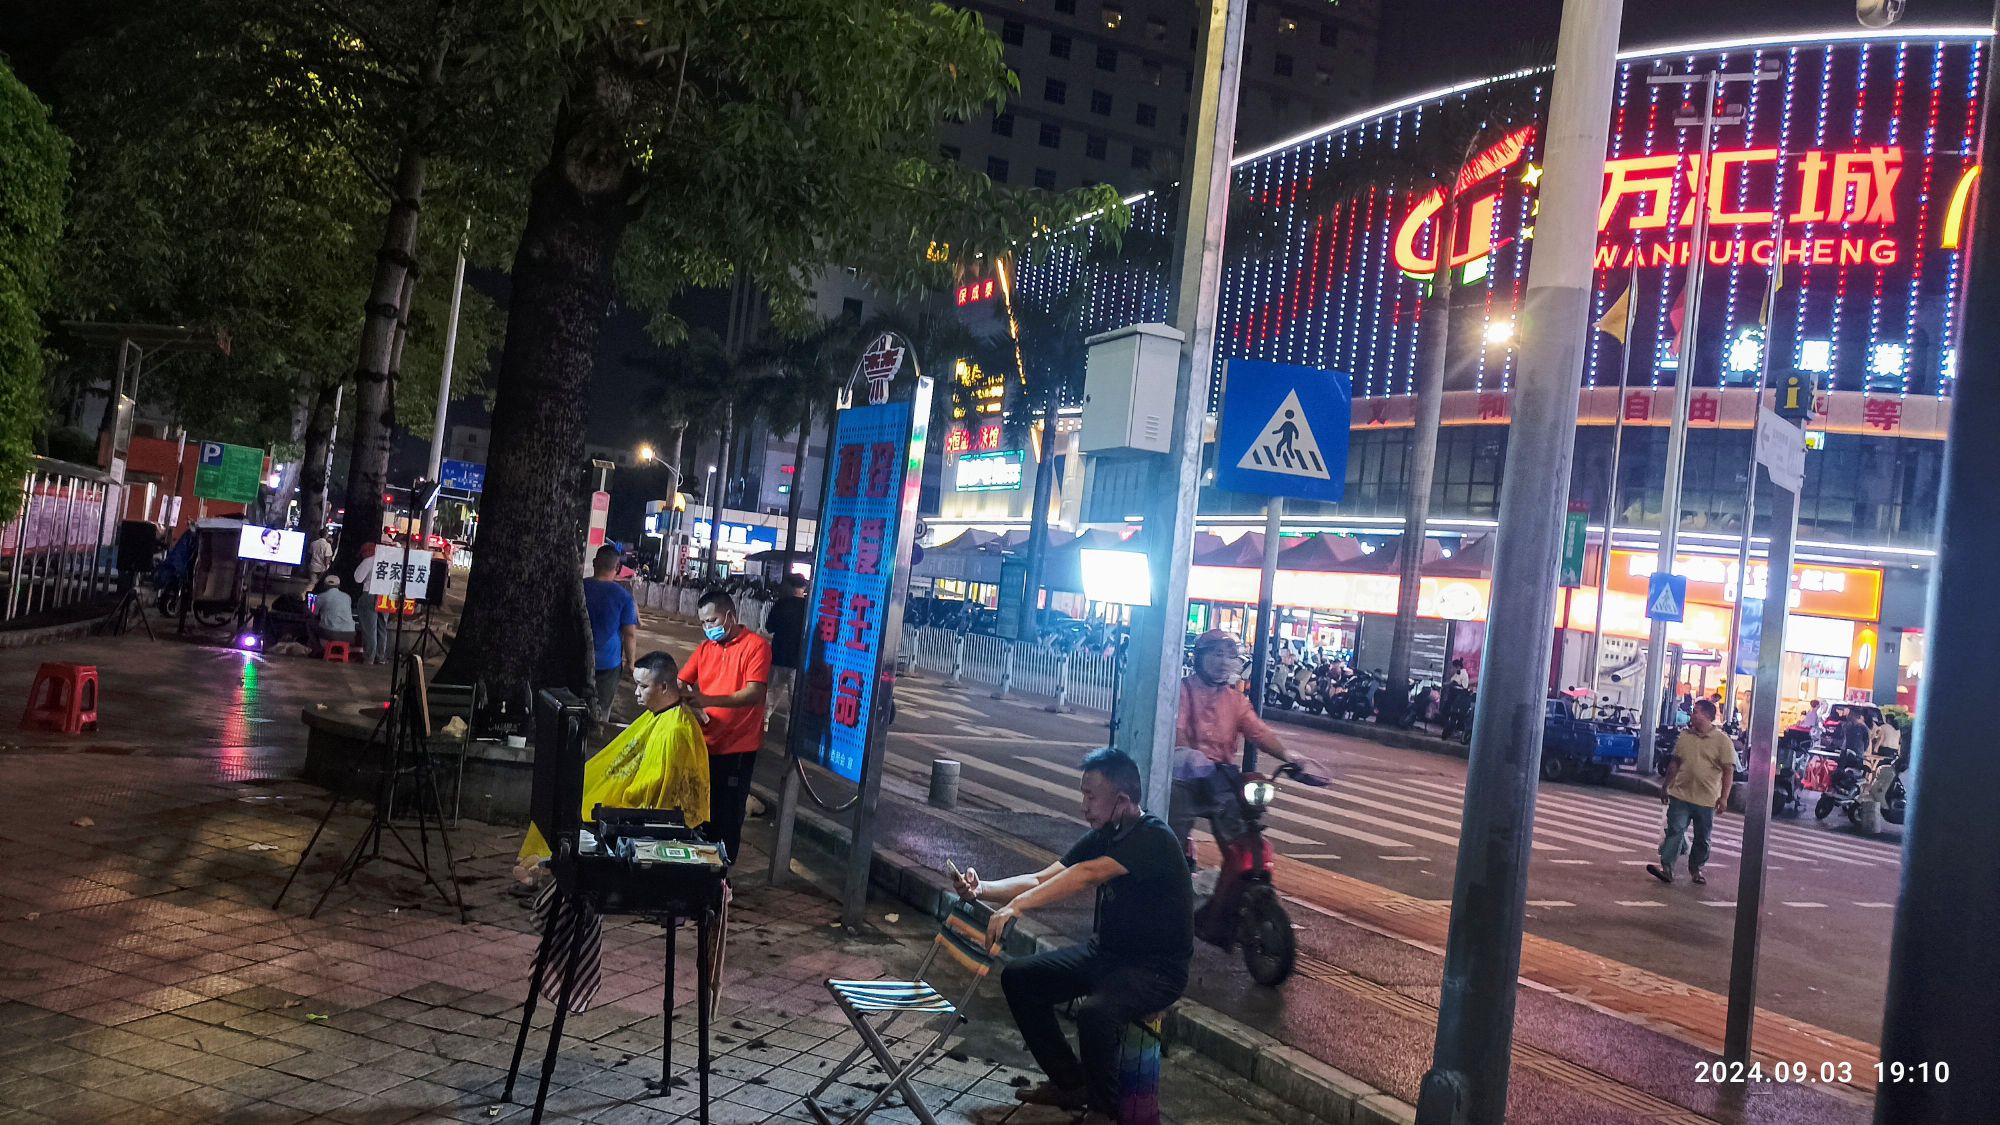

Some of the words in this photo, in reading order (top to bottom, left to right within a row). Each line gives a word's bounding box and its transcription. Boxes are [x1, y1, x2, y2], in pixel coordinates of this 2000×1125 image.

[1597, 147, 1902, 231] 万汇城
[1594, 239, 1897, 268] WANHUICHENG
[203, 443, 221, 463] P
